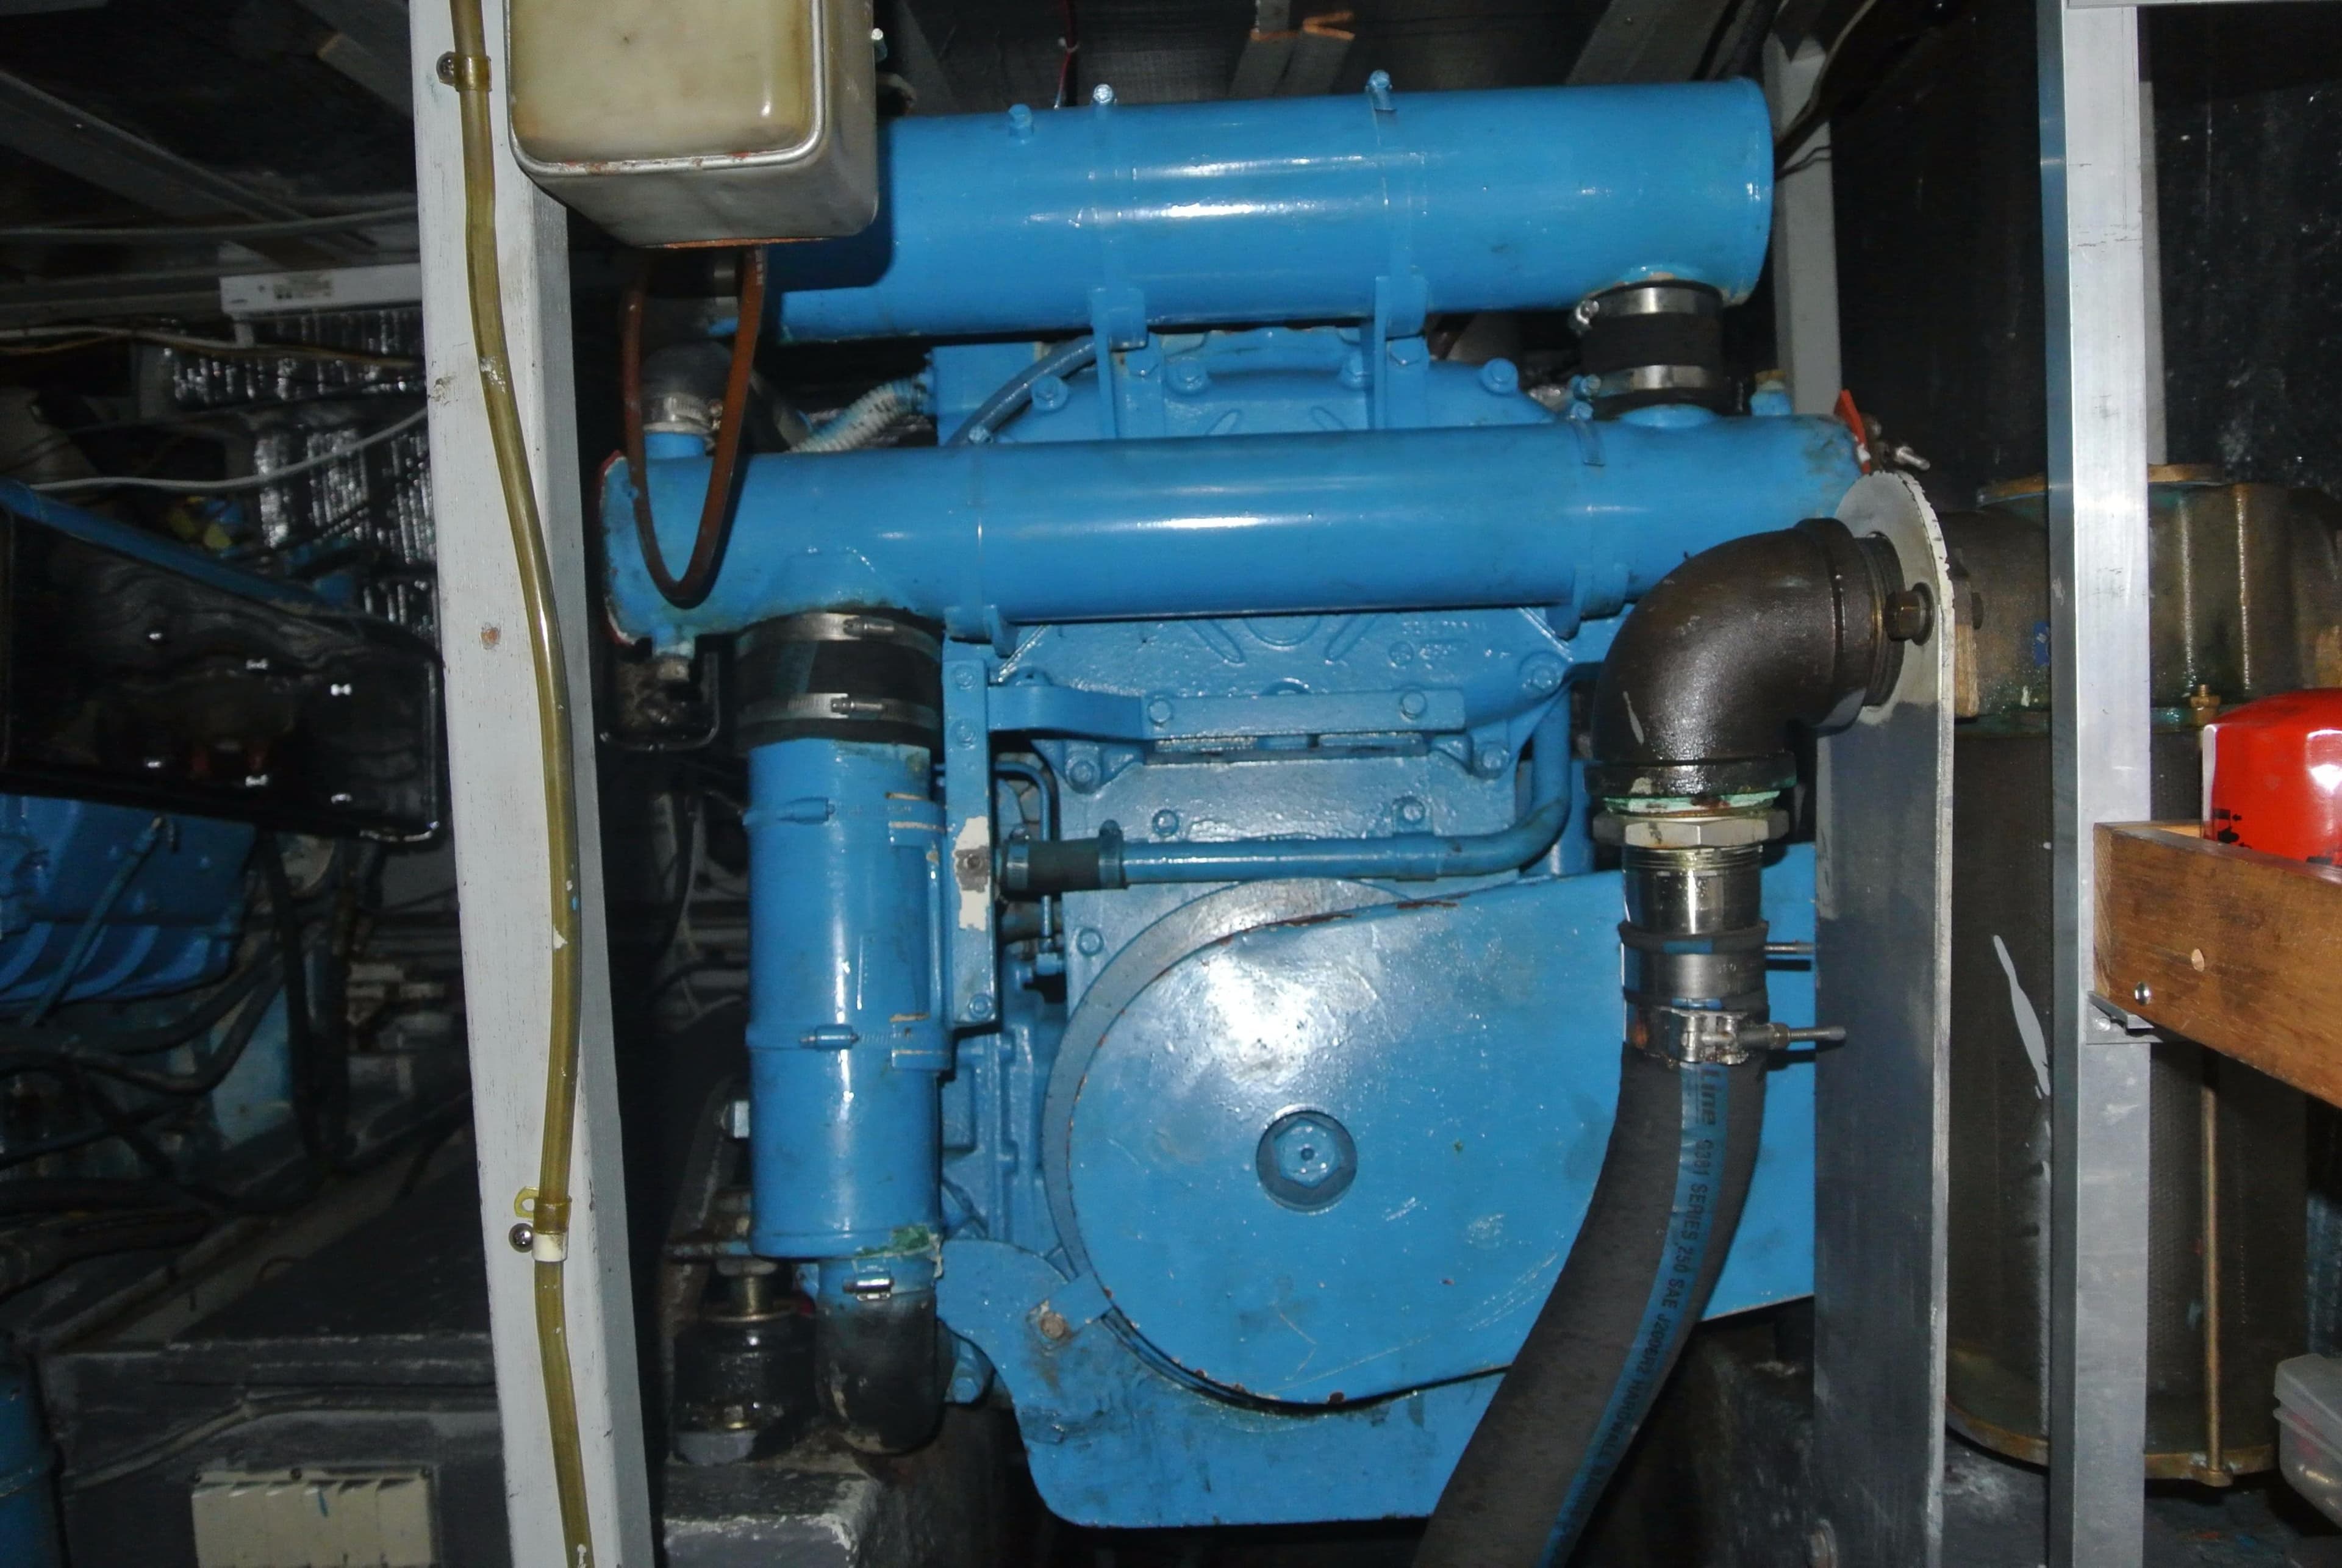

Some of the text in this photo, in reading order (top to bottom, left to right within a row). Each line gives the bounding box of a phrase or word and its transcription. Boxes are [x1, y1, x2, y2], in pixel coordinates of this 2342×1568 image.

[1700, 1069, 1720, 1126] Line
[1681, 1183, 1708, 1240] SERIES
[1673, 1245, 1694, 1273] 250
[1661, 1278, 1685, 1309] SAE
